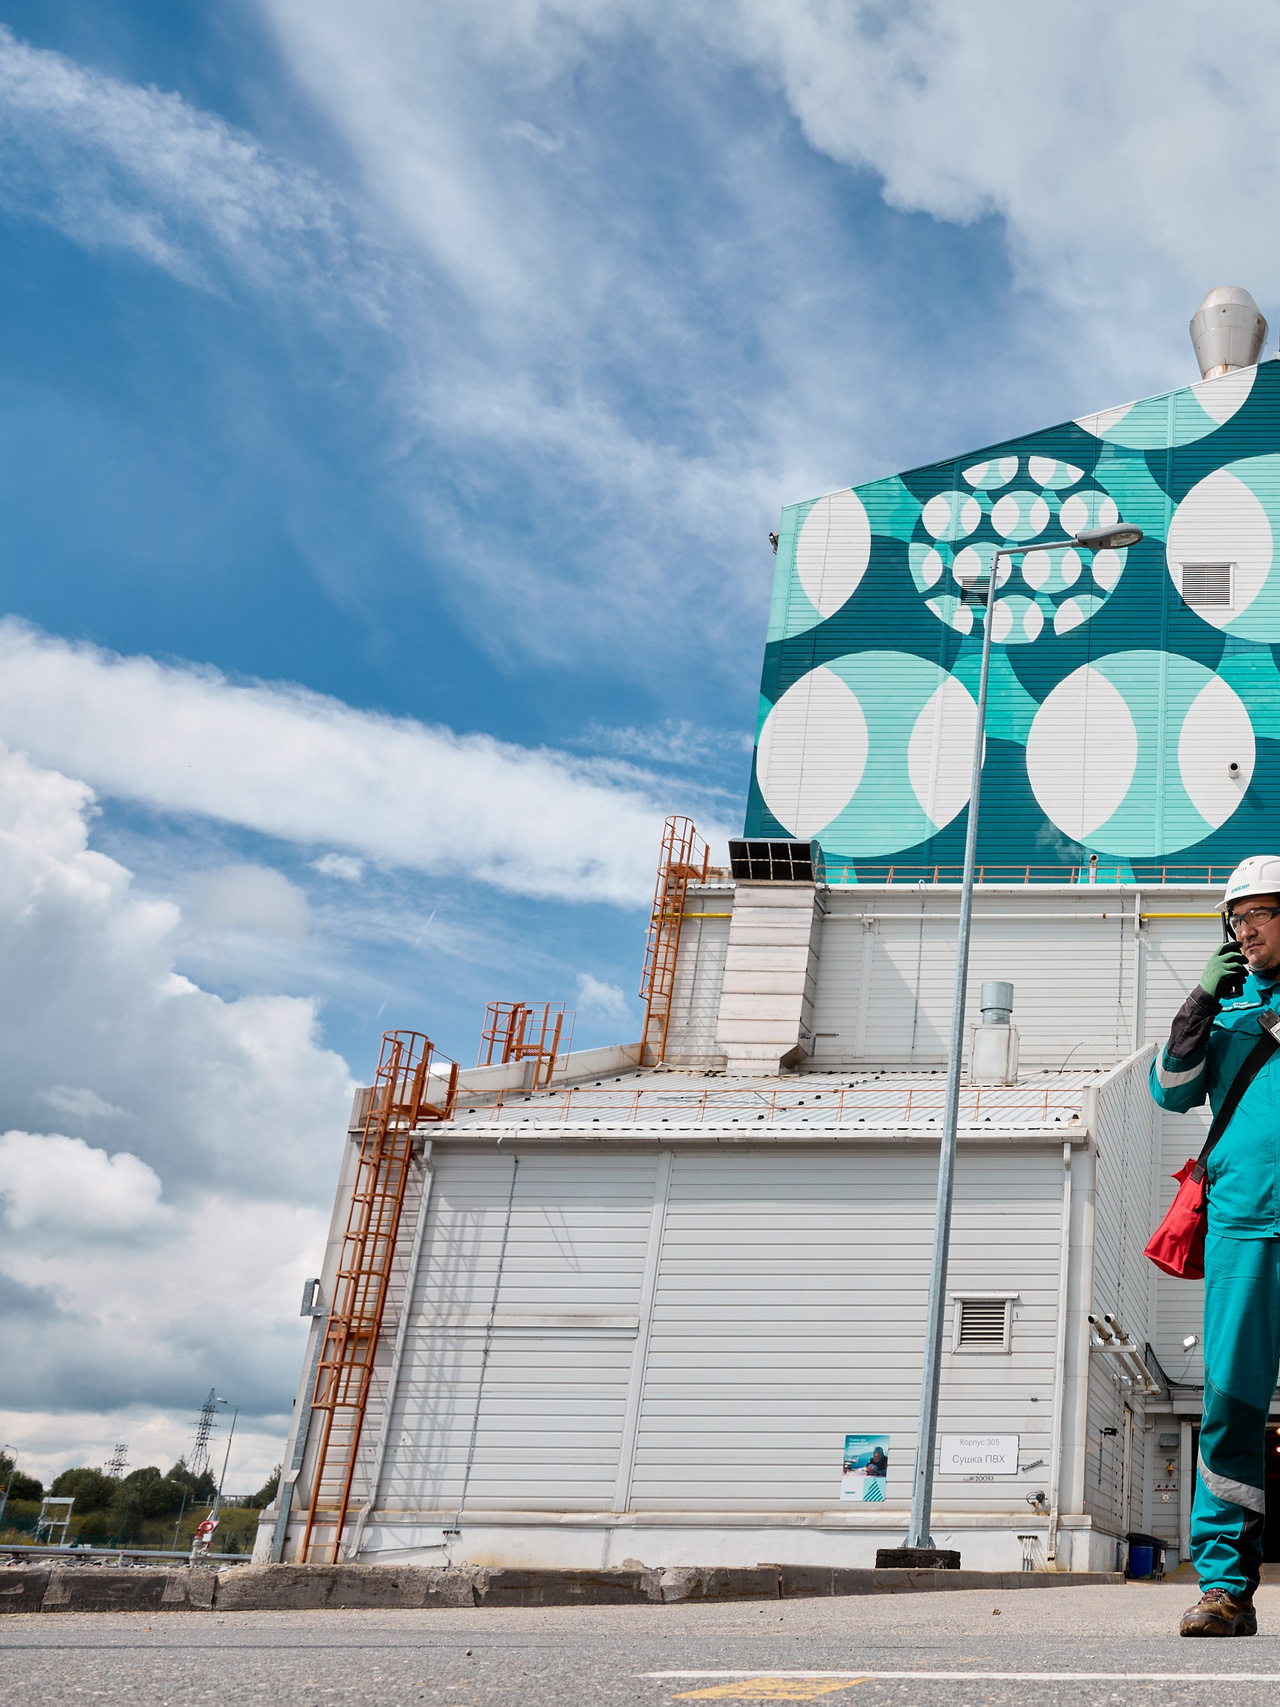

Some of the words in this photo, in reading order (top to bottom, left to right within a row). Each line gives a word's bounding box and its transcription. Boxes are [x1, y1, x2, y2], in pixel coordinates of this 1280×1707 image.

[960, 1439, 985, 1447] Корпус
[952, 1454, 983, 1466] Сушка
[985, 1454, 1006, 1464] ПВХ
